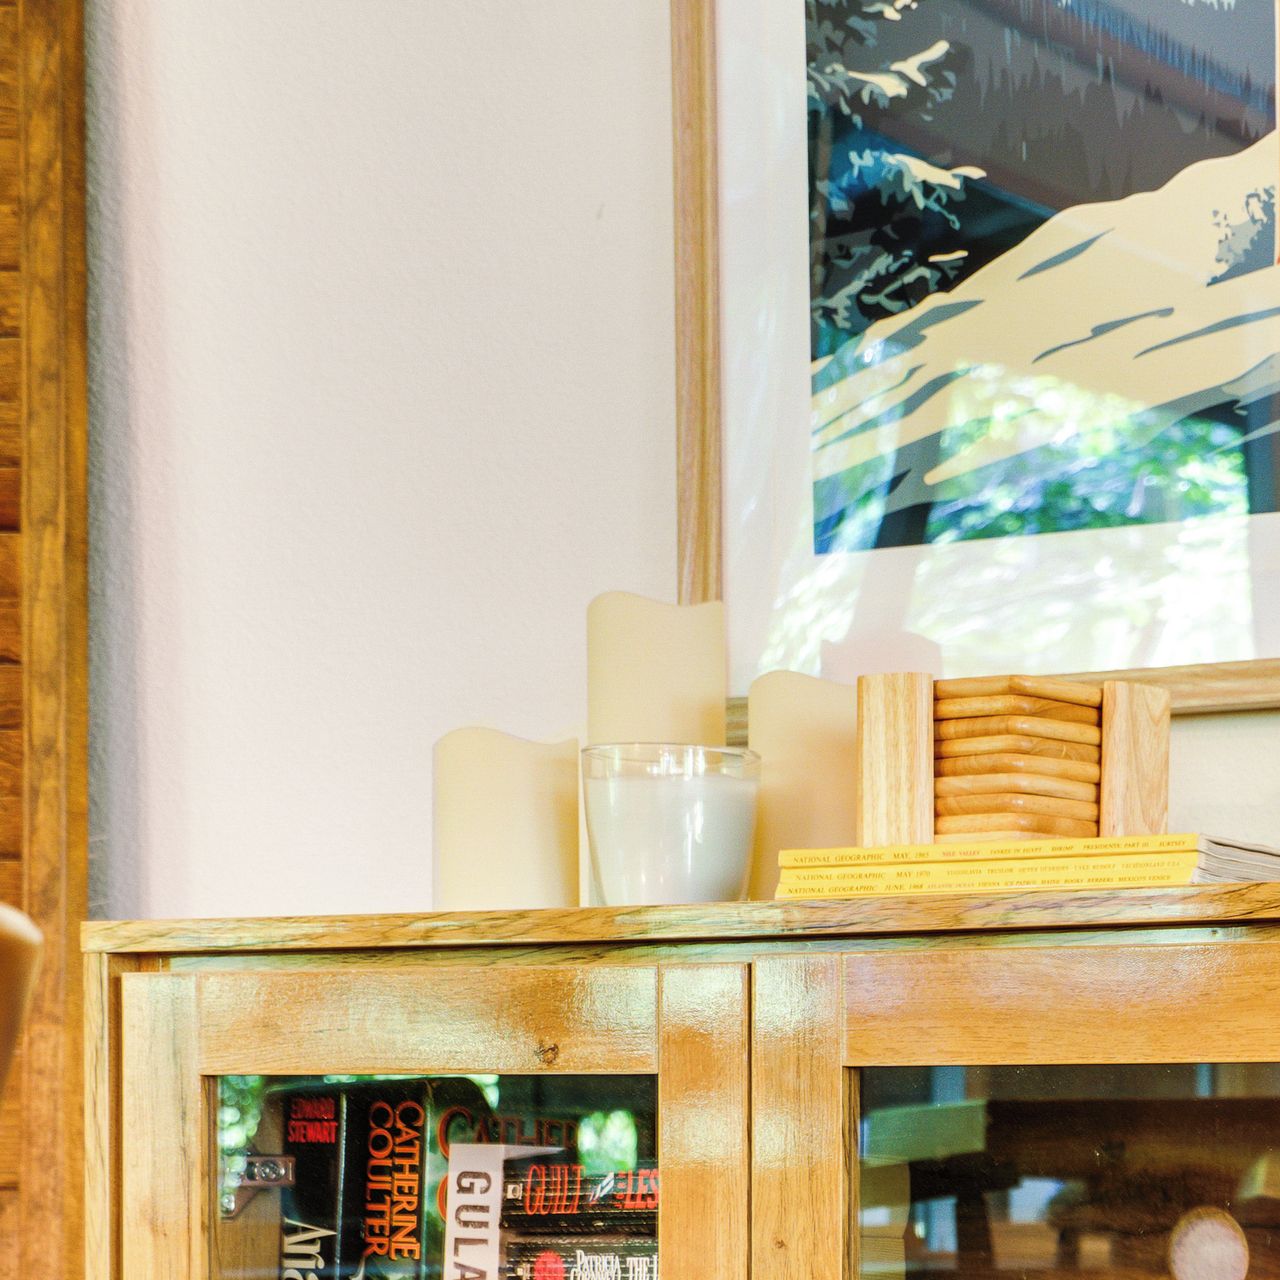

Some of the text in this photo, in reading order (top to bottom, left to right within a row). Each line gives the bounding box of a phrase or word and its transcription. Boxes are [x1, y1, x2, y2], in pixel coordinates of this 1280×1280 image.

[793, 855, 831, 864] NATIONAL
[834, 852, 885, 862] GEOGRAPHIC
[363, 1100, 395, 1257] COULTER
[388, 1100, 426, 1261] CATHERINE
